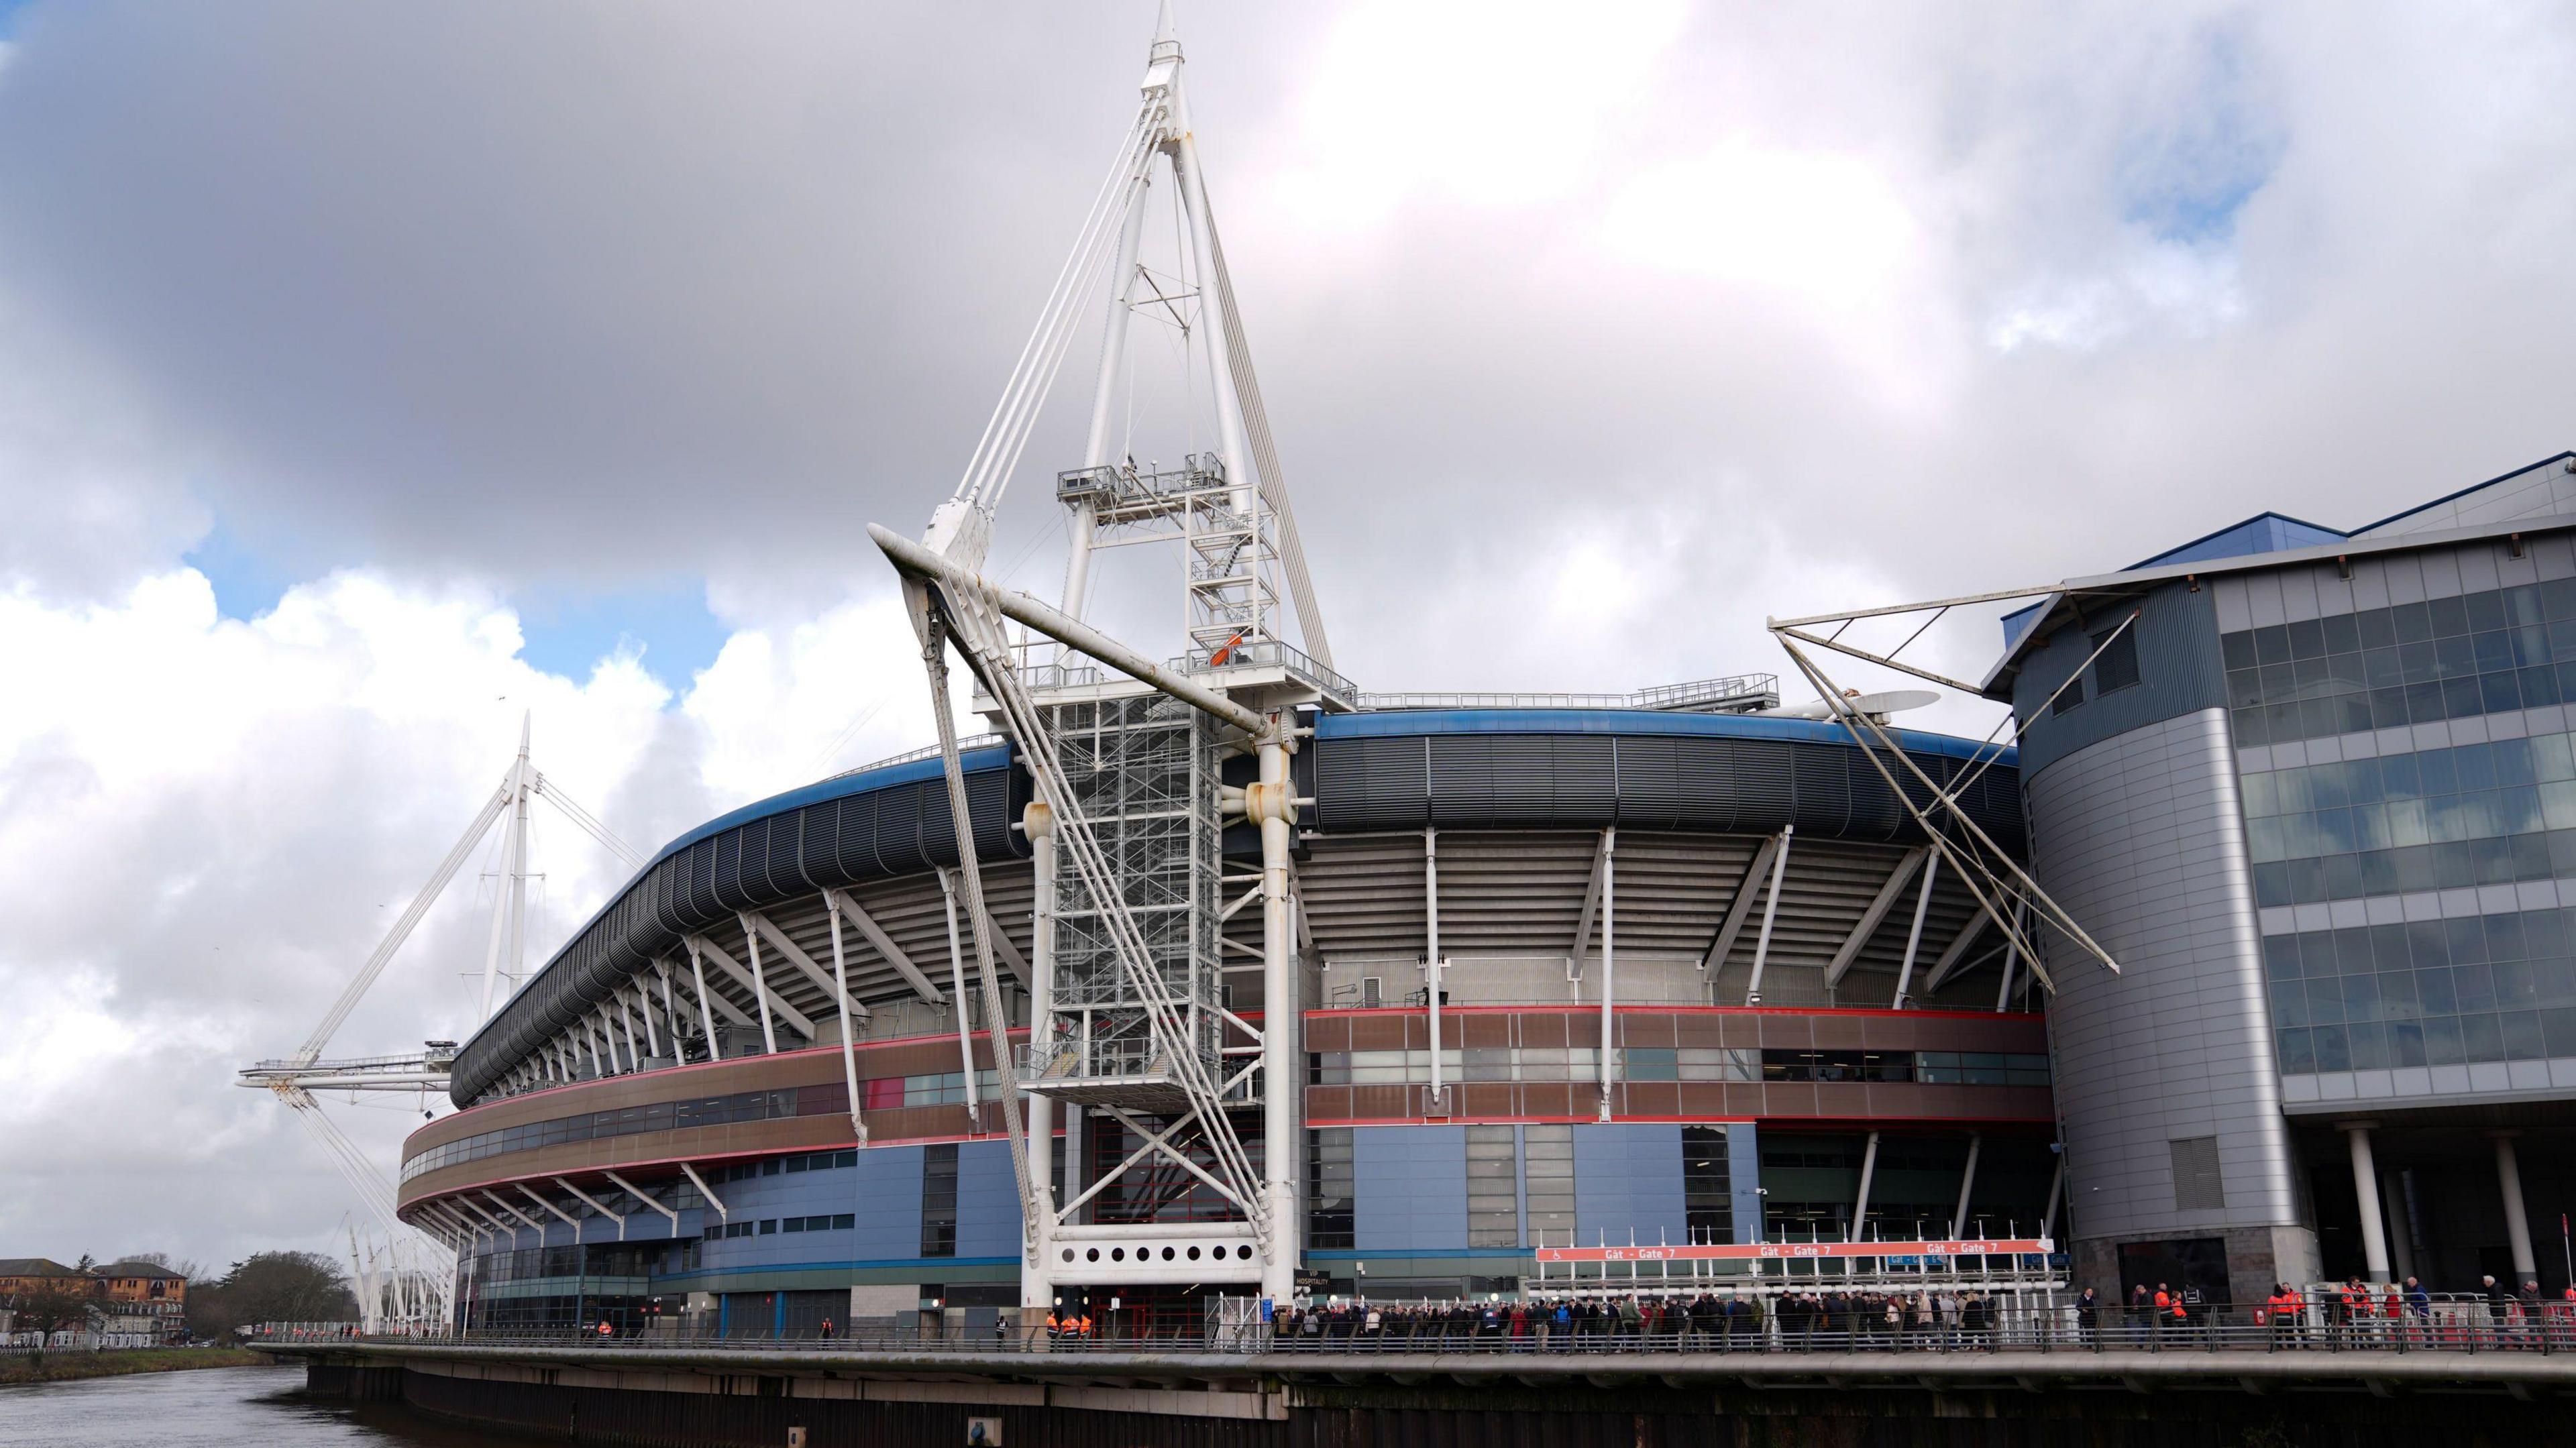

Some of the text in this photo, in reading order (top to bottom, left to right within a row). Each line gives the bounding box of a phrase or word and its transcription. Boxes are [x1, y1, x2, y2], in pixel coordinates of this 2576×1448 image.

[1639, 1248, 1663, 1259] Gate
[1668, 1248, 1675, 1258] 7
[1794, 1245, 1818, 1256] Gate
[1824, 1245, 1831, 1256] 7
[1960, 1243, 1985, 1253] Gate
[1990, 1243, 1997, 1252] 7
